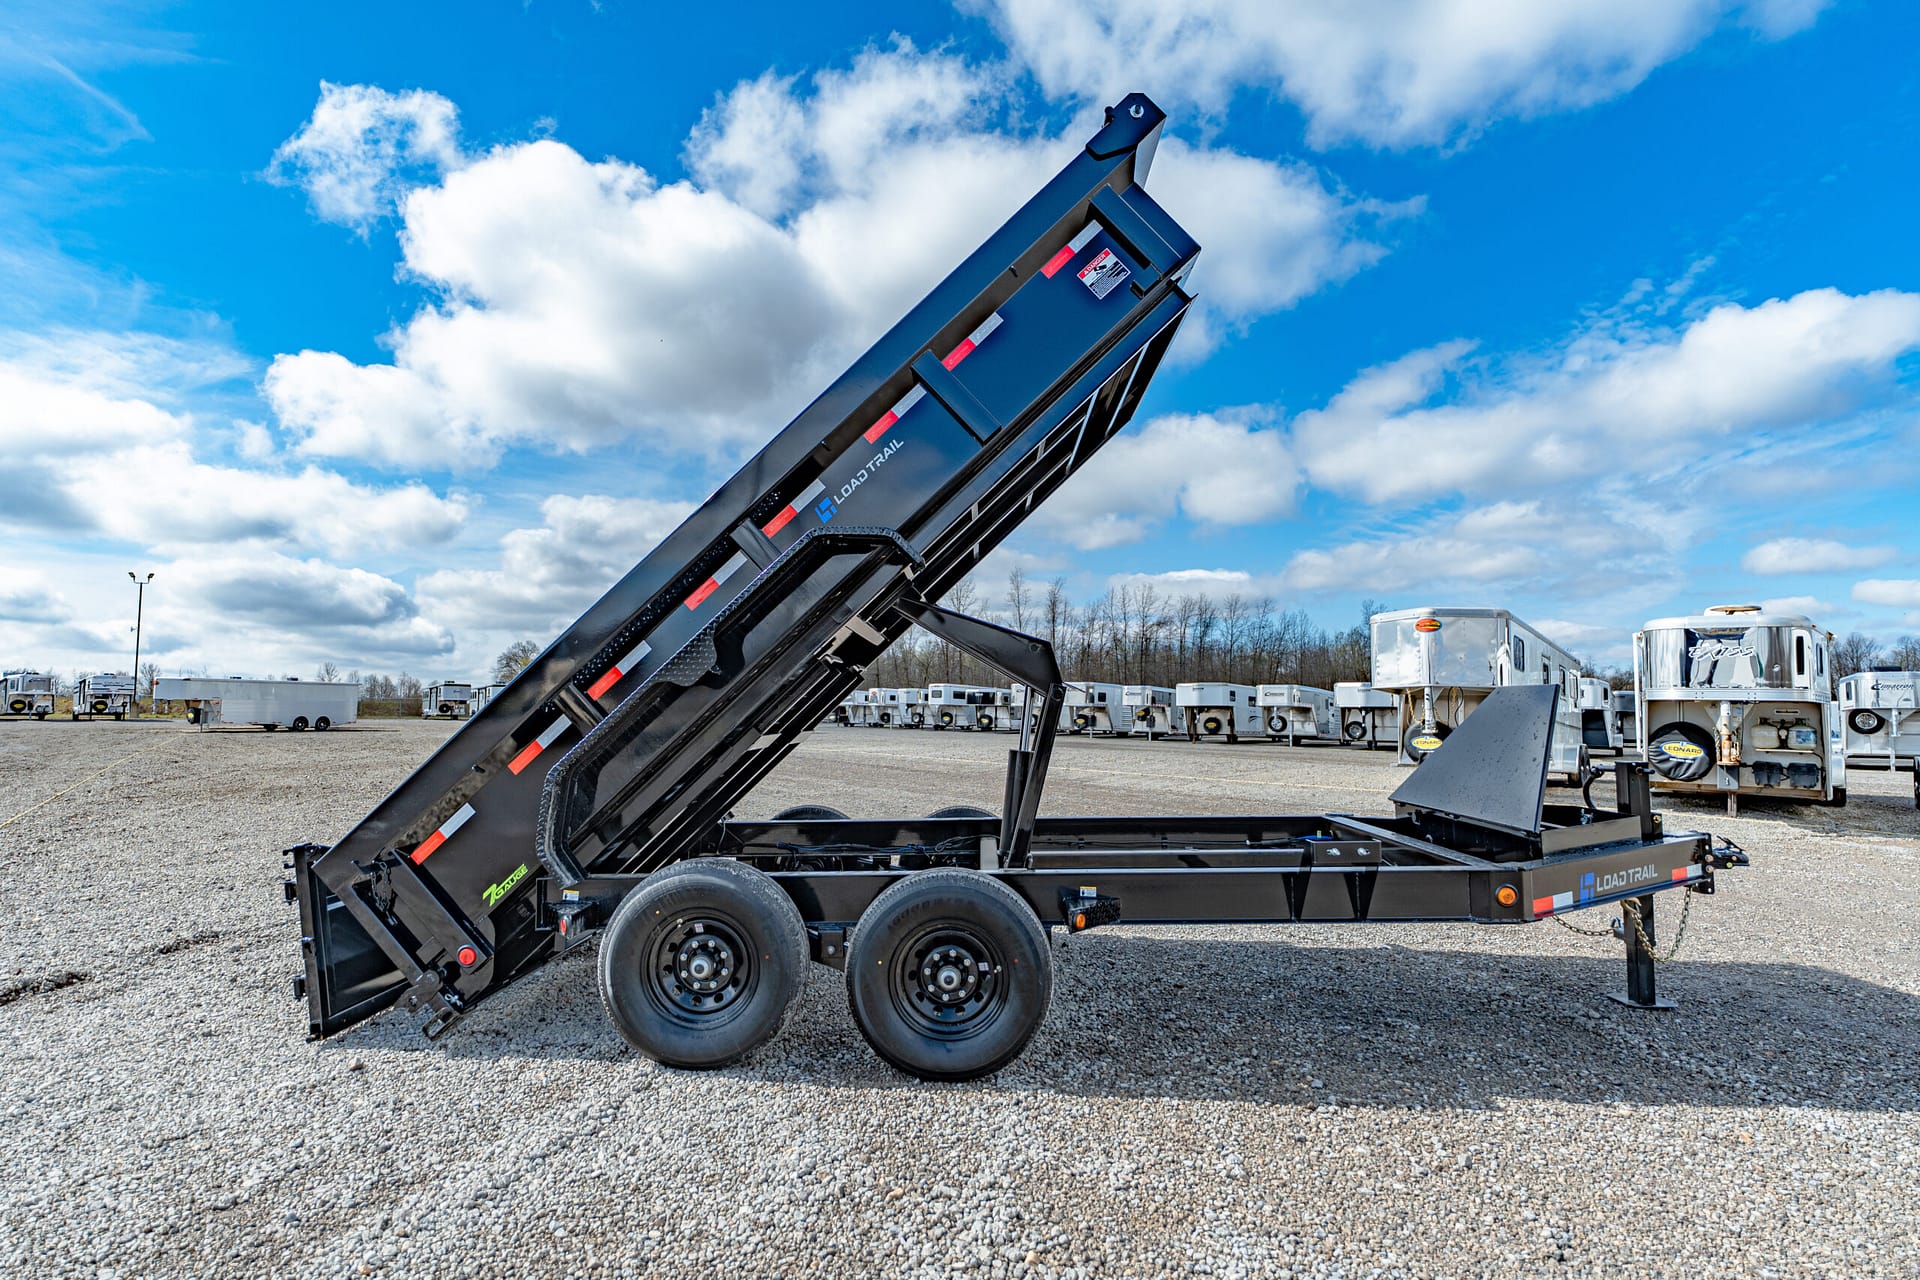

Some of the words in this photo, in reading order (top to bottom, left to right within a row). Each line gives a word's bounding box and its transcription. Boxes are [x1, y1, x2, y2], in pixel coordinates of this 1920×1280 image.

[1086, 253, 1106, 272] DANGER
[833, 469, 868, 505] LOAD
[866, 439, 905, 472] TRAIL
[1663, 745, 1702, 755] LEONARD
[482, 883, 497, 907] 7
[495, 864, 529, 899] GAUGE
[1596, 870, 1627, 892] LOAD
[1628, 864, 1658, 884] TRAIL
